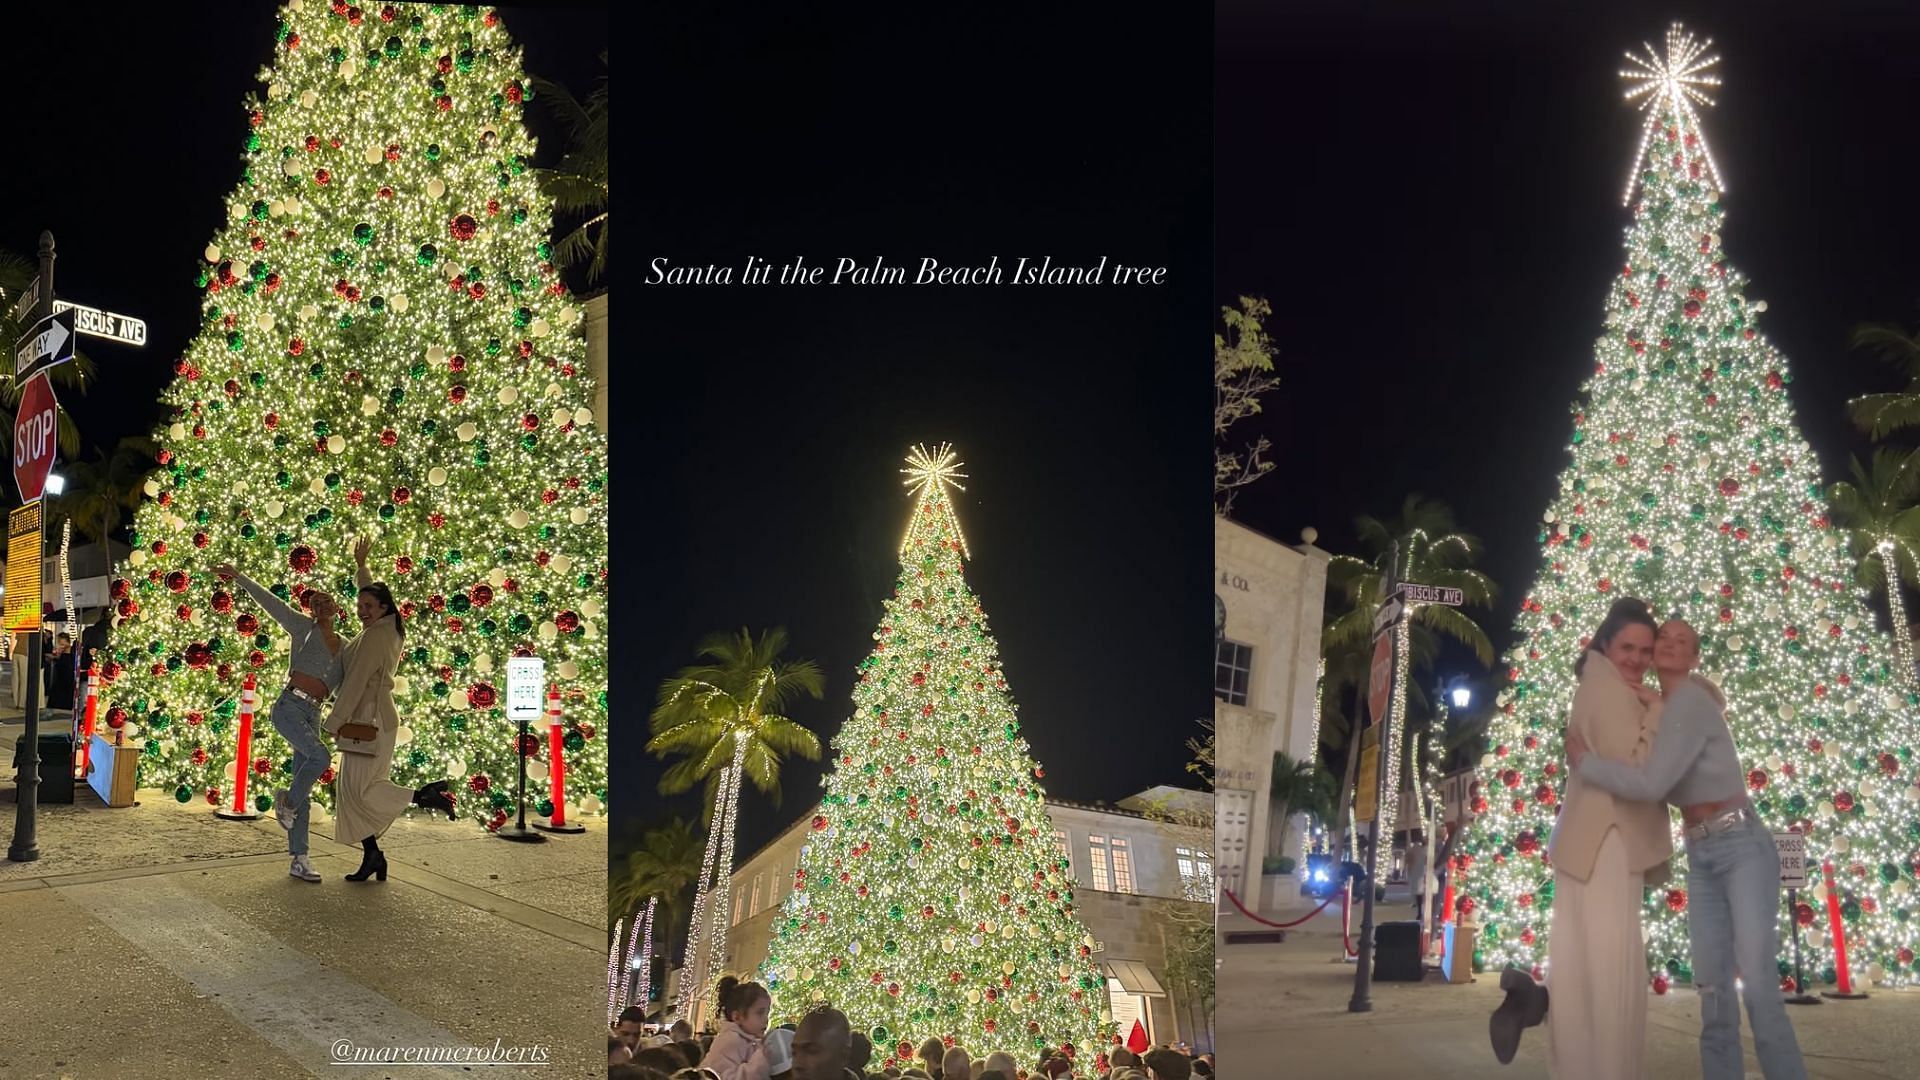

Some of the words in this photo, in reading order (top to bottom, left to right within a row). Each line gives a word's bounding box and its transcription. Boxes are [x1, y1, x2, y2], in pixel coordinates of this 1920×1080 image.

[119, 319, 142, 341] AVE
[32, 332, 50, 359] WAY
[17, 408, 53, 468] STOP
[1443, 590, 1460, 603] AVE
[512, 667, 539, 680] CROSS
[514, 686, 536, 699] HERE
